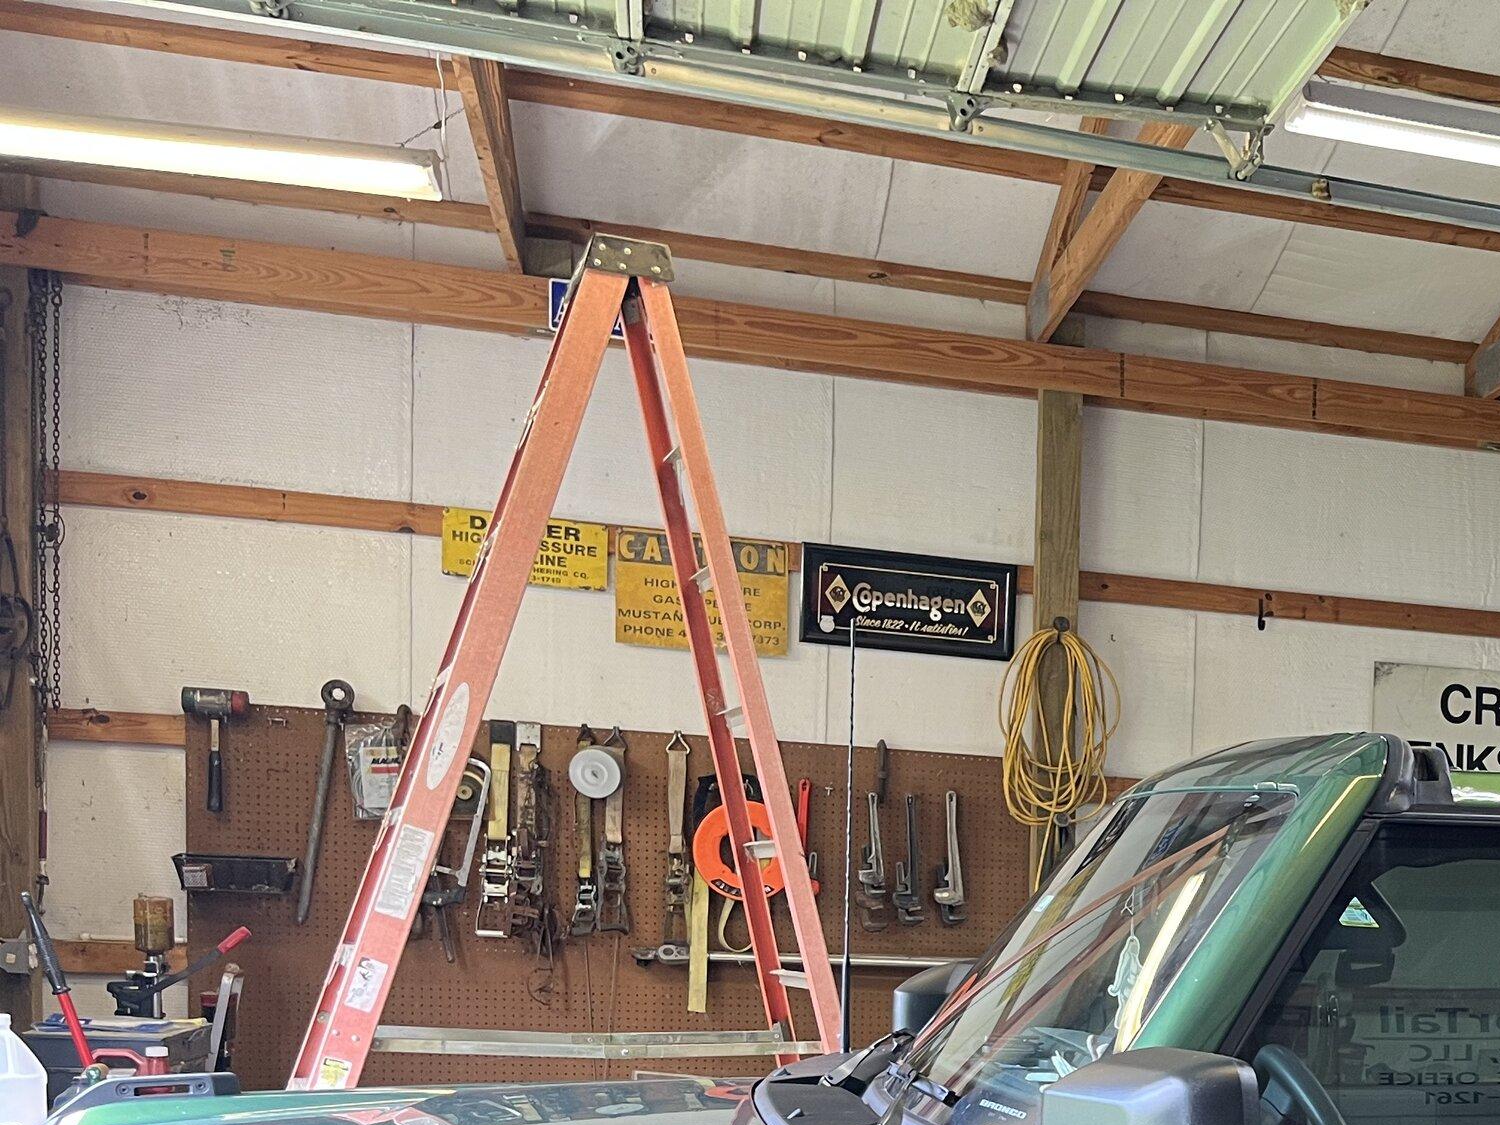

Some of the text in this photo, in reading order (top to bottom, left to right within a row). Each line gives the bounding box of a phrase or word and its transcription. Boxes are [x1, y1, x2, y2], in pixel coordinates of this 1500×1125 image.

[469, 515, 581, 542] DER
[451, 530, 598, 557] HIG SSURE
[619, 534, 786, 573] CAON
[534, 555, 567, 568] INE
[533, 567, 569, 577] HERING
[653, 594, 682, 606] GAS
[852, 583, 966, 621] Copenhagen
[618, 608, 684, 622] MUSTAN
[855, 615, 881, 628] Since
[881, 618, 905, 630] 1822
[623, 624, 674, 638] PHONE
[979, 1098, 1027, 1119] BRONCO
